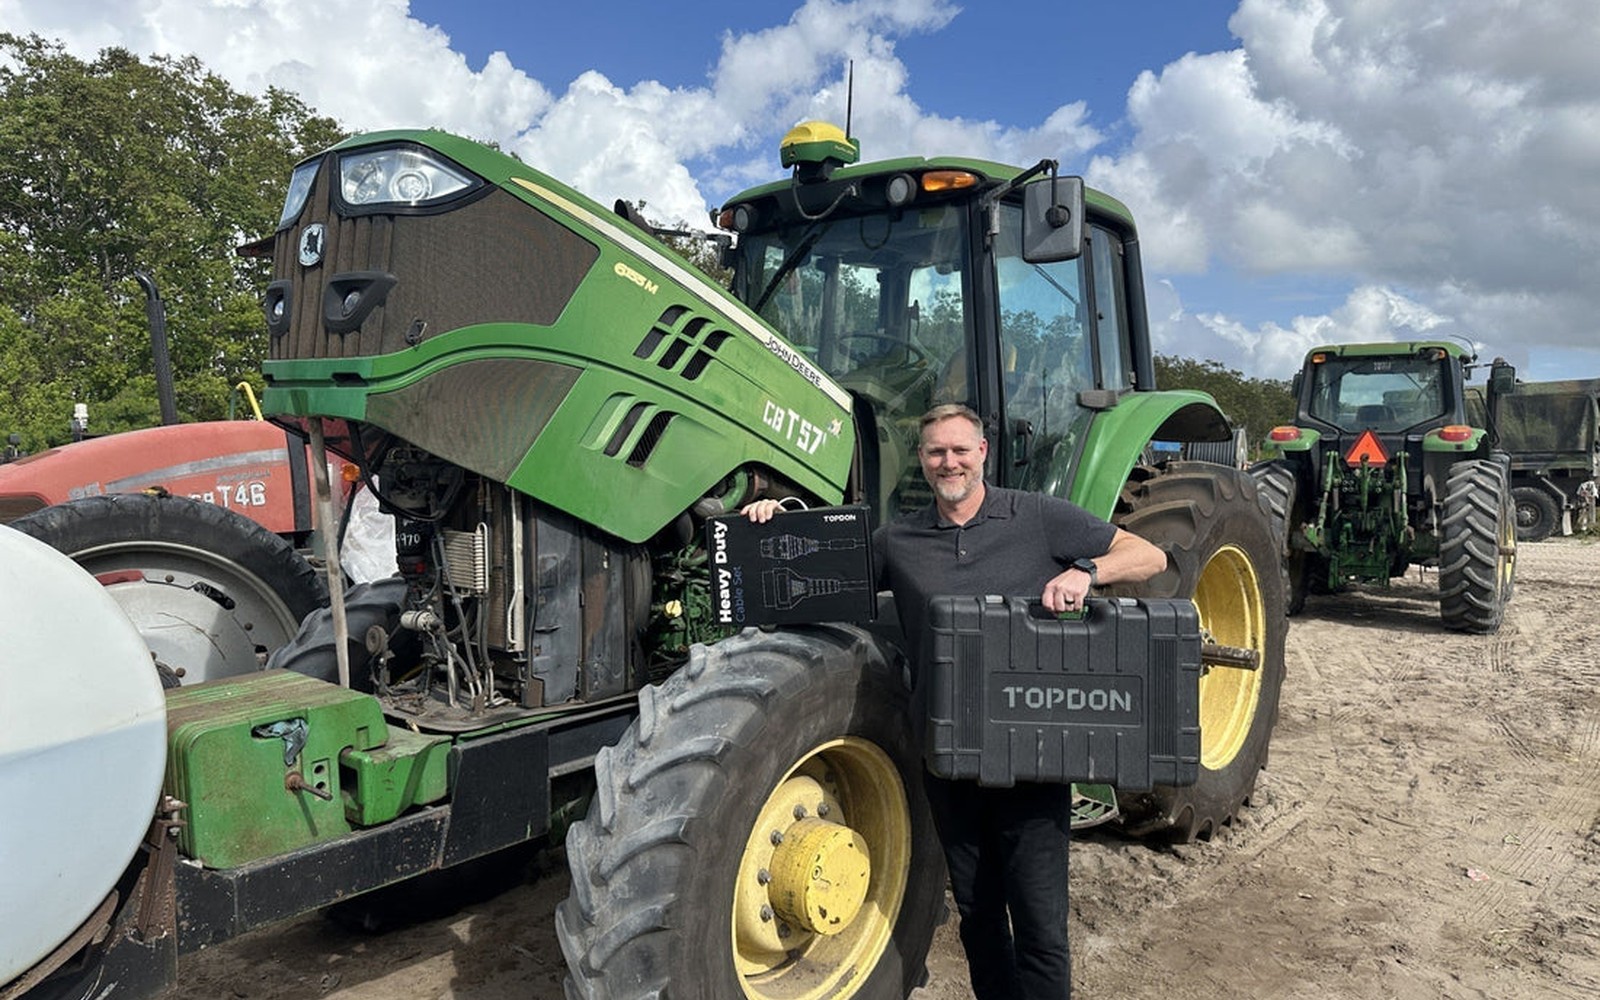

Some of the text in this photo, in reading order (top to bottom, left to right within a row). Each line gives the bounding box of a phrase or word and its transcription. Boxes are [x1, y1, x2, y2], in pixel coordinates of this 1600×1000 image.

[765, 336, 821, 387] JOHN DEERE
[823, 514, 857, 523] TOPDON
[713, 520, 733, 623] Heavy Duty
[732, 565, 746, 623] Cable Set
[1002, 686, 1132, 712] TOPDON
